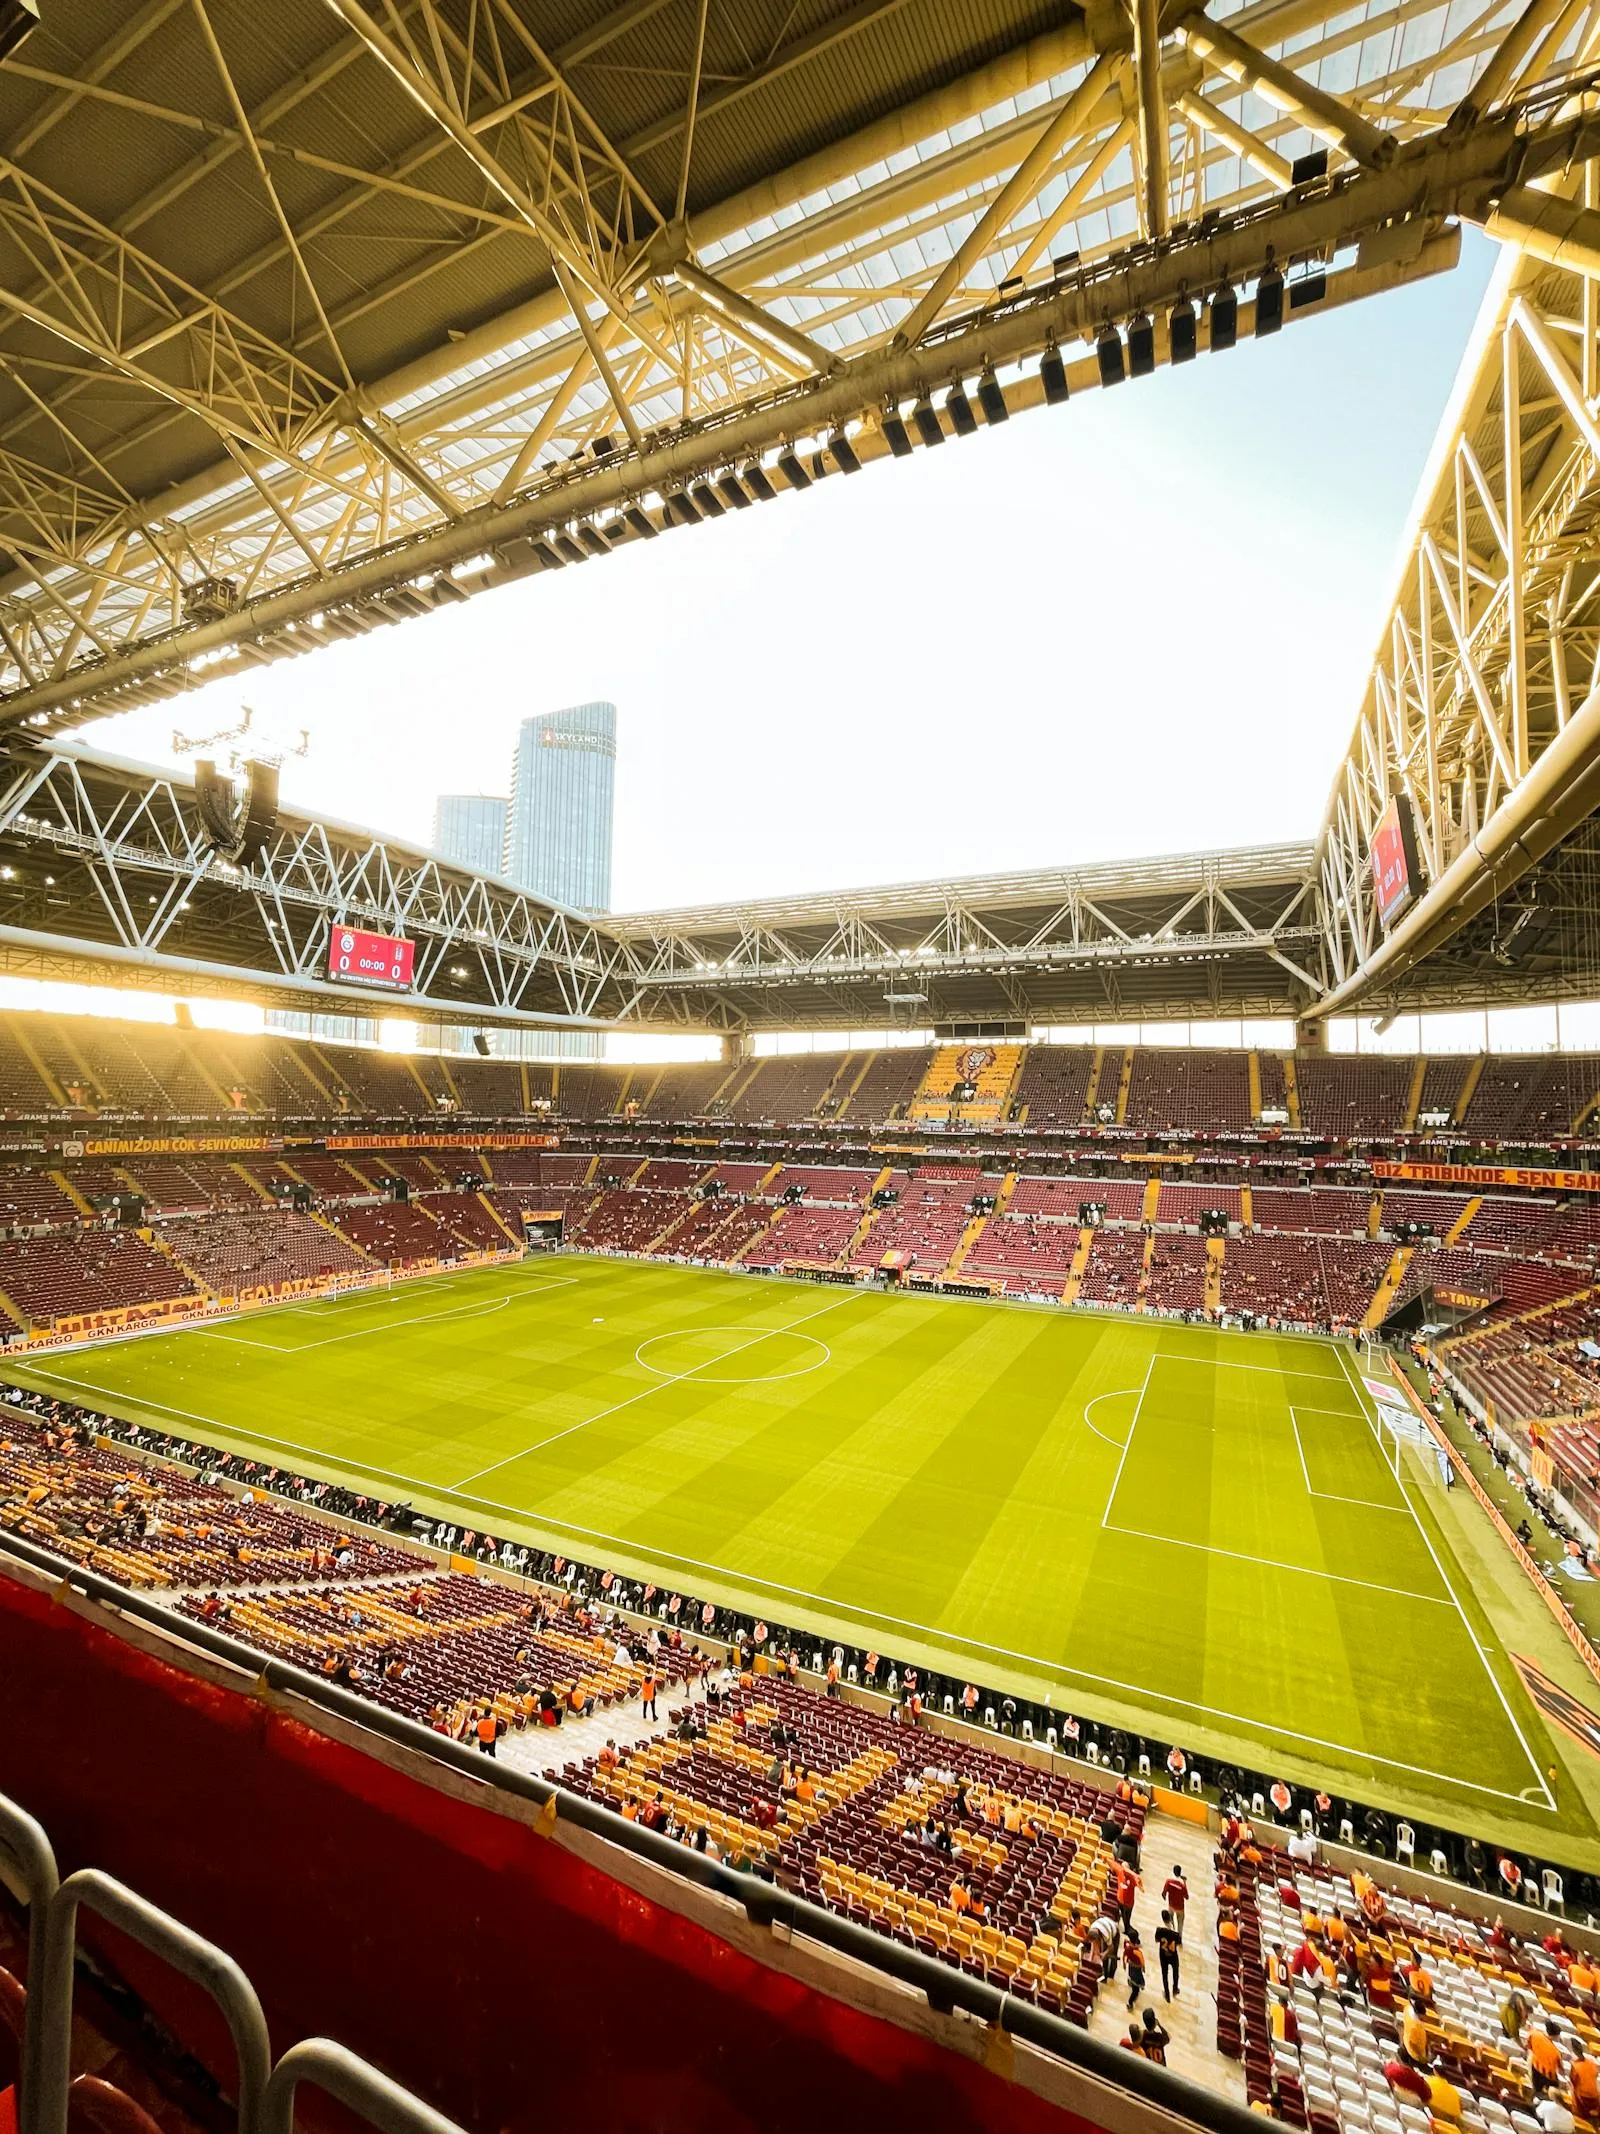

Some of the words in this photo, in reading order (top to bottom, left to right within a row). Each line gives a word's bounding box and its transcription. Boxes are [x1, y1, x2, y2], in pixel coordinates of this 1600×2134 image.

[555, 733, 598, 744] SKYLAND
[340, 956, 350, 970] 0
[360, 958, 384, 971] 00:00
[392, 965, 400, 979] 0
[85, 1139, 170, 1154] CANIMIZDAN
[326, 1136, 348, 1148] HEP
[352, 1136, 401, 1148] BIRLIKTE
[406, 1136, 486, 1146] GALATASARAY
[491, 1136, 520, 1145] RUHU
[1517, 1172, 1556, 1186] SEN
[348, 1280, 372, 1289] KARGO
[260, 1296, 281, 1306] GKN
[282, 1290, 312, 1302] KARGO
[182, 1311, 204, 1320] GKN
[206, 1304, 240, 1316] KARGO
[88, 1328, 114, 1338] GKN
[117, 1319, 156, 1333] KARGO
[26, 1334, 72, 1350] KARGO
[1562, 1610, 1579, 1646] GKN
[1580, 1637, 1600, 1678] KAR
[646, 1809, 654, 1822] 9
